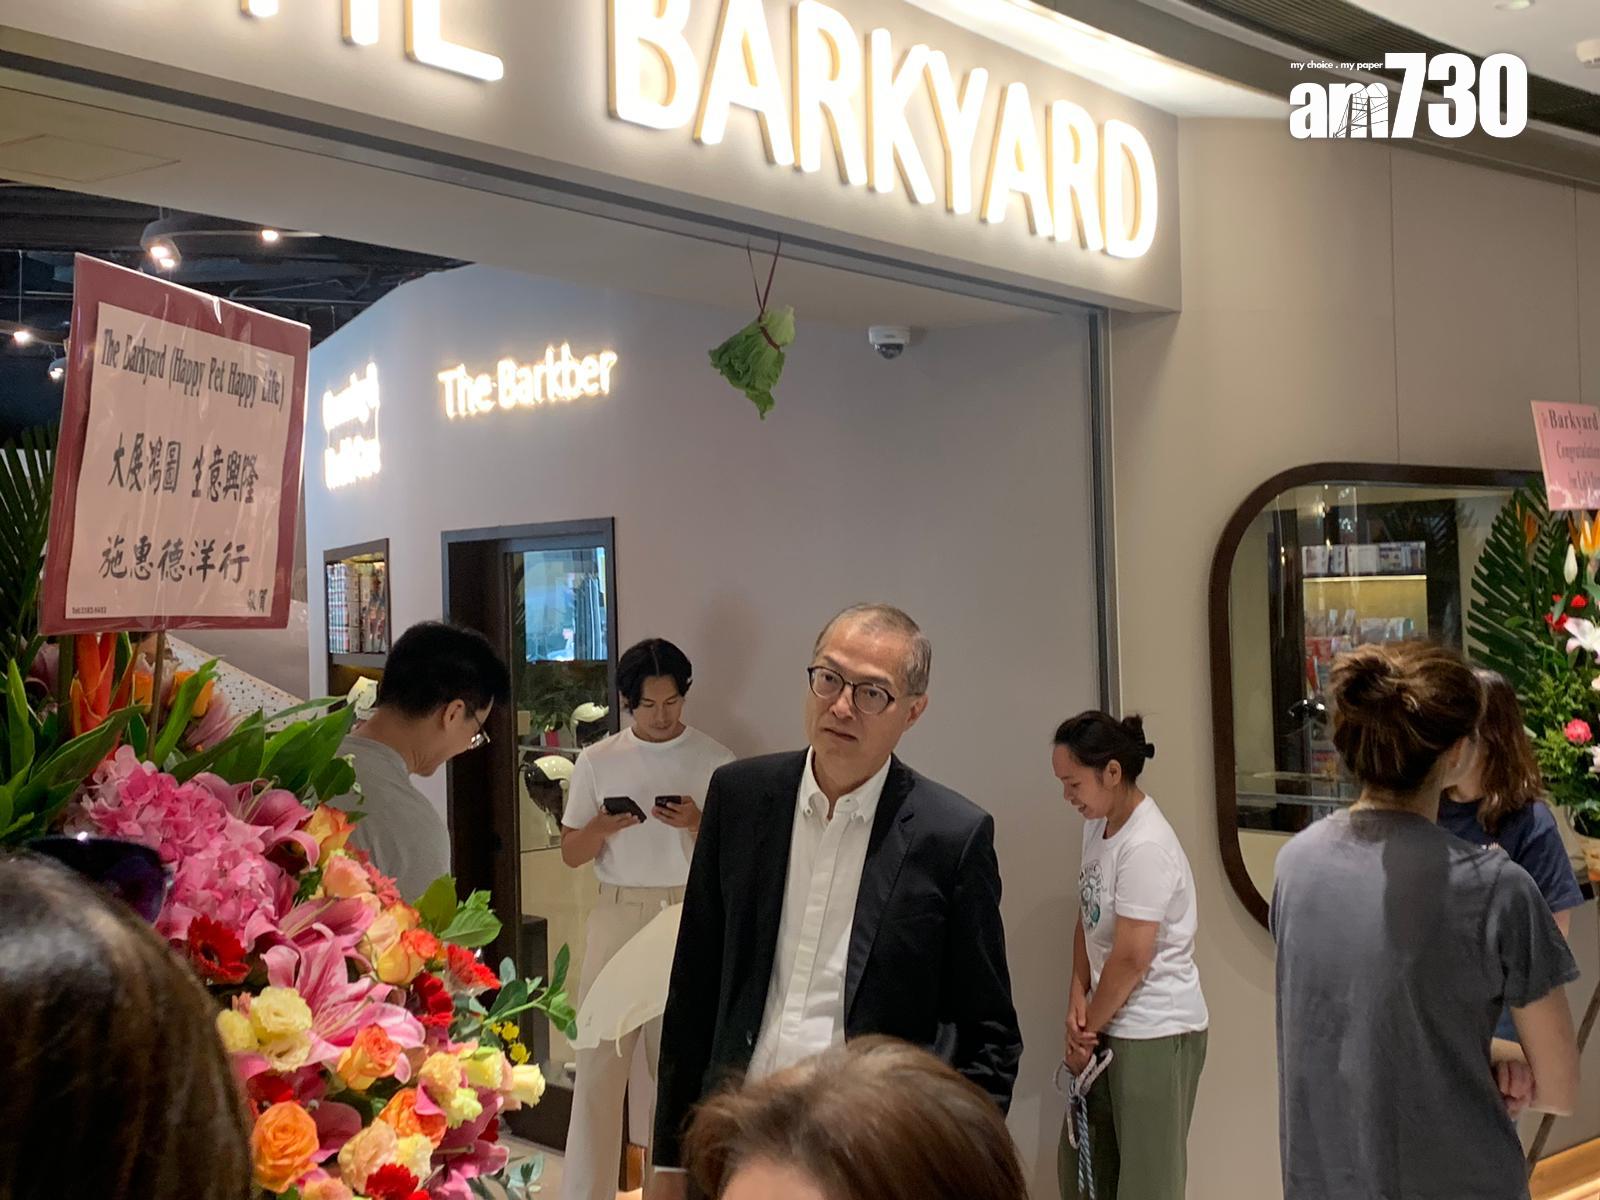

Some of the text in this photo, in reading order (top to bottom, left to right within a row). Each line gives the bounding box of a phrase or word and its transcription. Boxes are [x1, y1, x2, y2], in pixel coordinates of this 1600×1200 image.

[607, 0, 1158, 260] BARKYARD
[101, 328, 120, 368] The
[122, 334, 167, 385] Barkyard
[208, 357, 226, 393] Pet
[228, 361, 259, 408] Happy
[437, 363, 495, 419] The
[497, 342, 618, 410] Barkber
[1548, 408, 1599, 435] Barkyard
[191, 445, 260, 504] 生意興隆
[99, 535, 250, 584] 施惠德洋行
